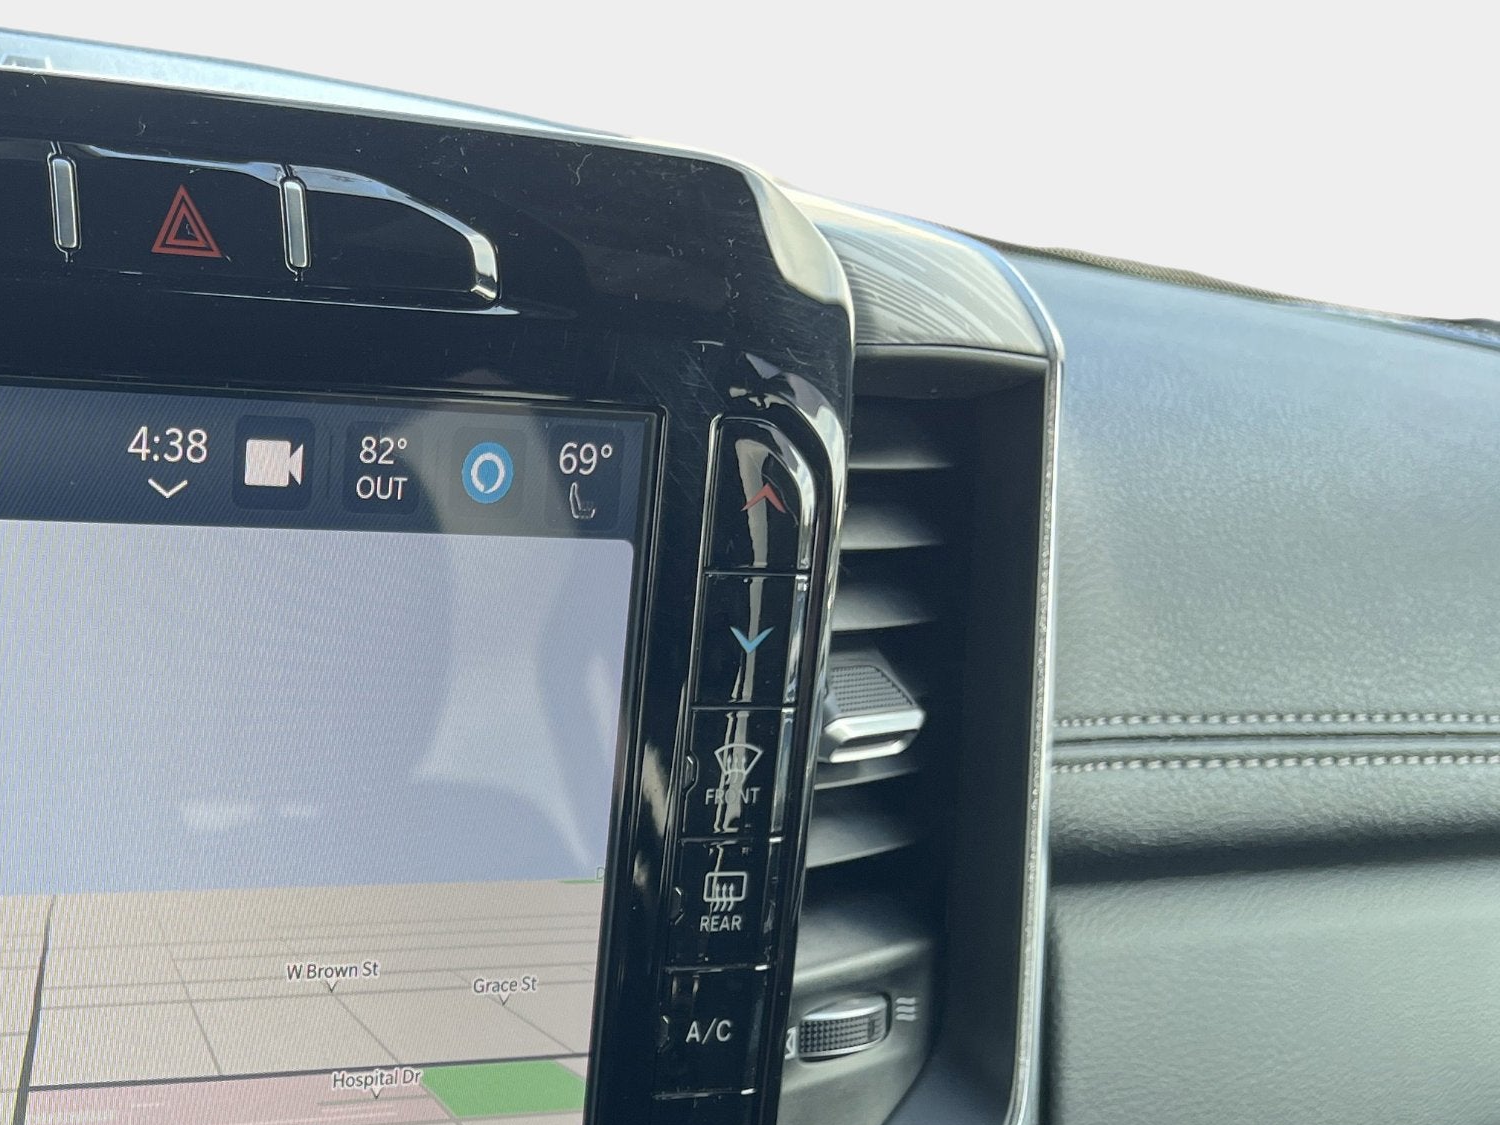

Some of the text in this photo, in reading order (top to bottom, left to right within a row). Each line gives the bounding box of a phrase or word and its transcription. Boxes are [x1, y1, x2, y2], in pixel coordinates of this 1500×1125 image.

[127, 425, 208, 464] 4:38
[359, 436, 407, 465] 82°
[558, 443, 613, 476] 69°
[356, 475, 407, 501] OUT
[700, 915, 742, 932] REAR
[286, 961, 378, 980] W Brown St
[473, 976, 537, 994] Grace St
[685, 1018, 733, 1045] A/C
[333, 1069, 421, 1090] Hospital Dr
